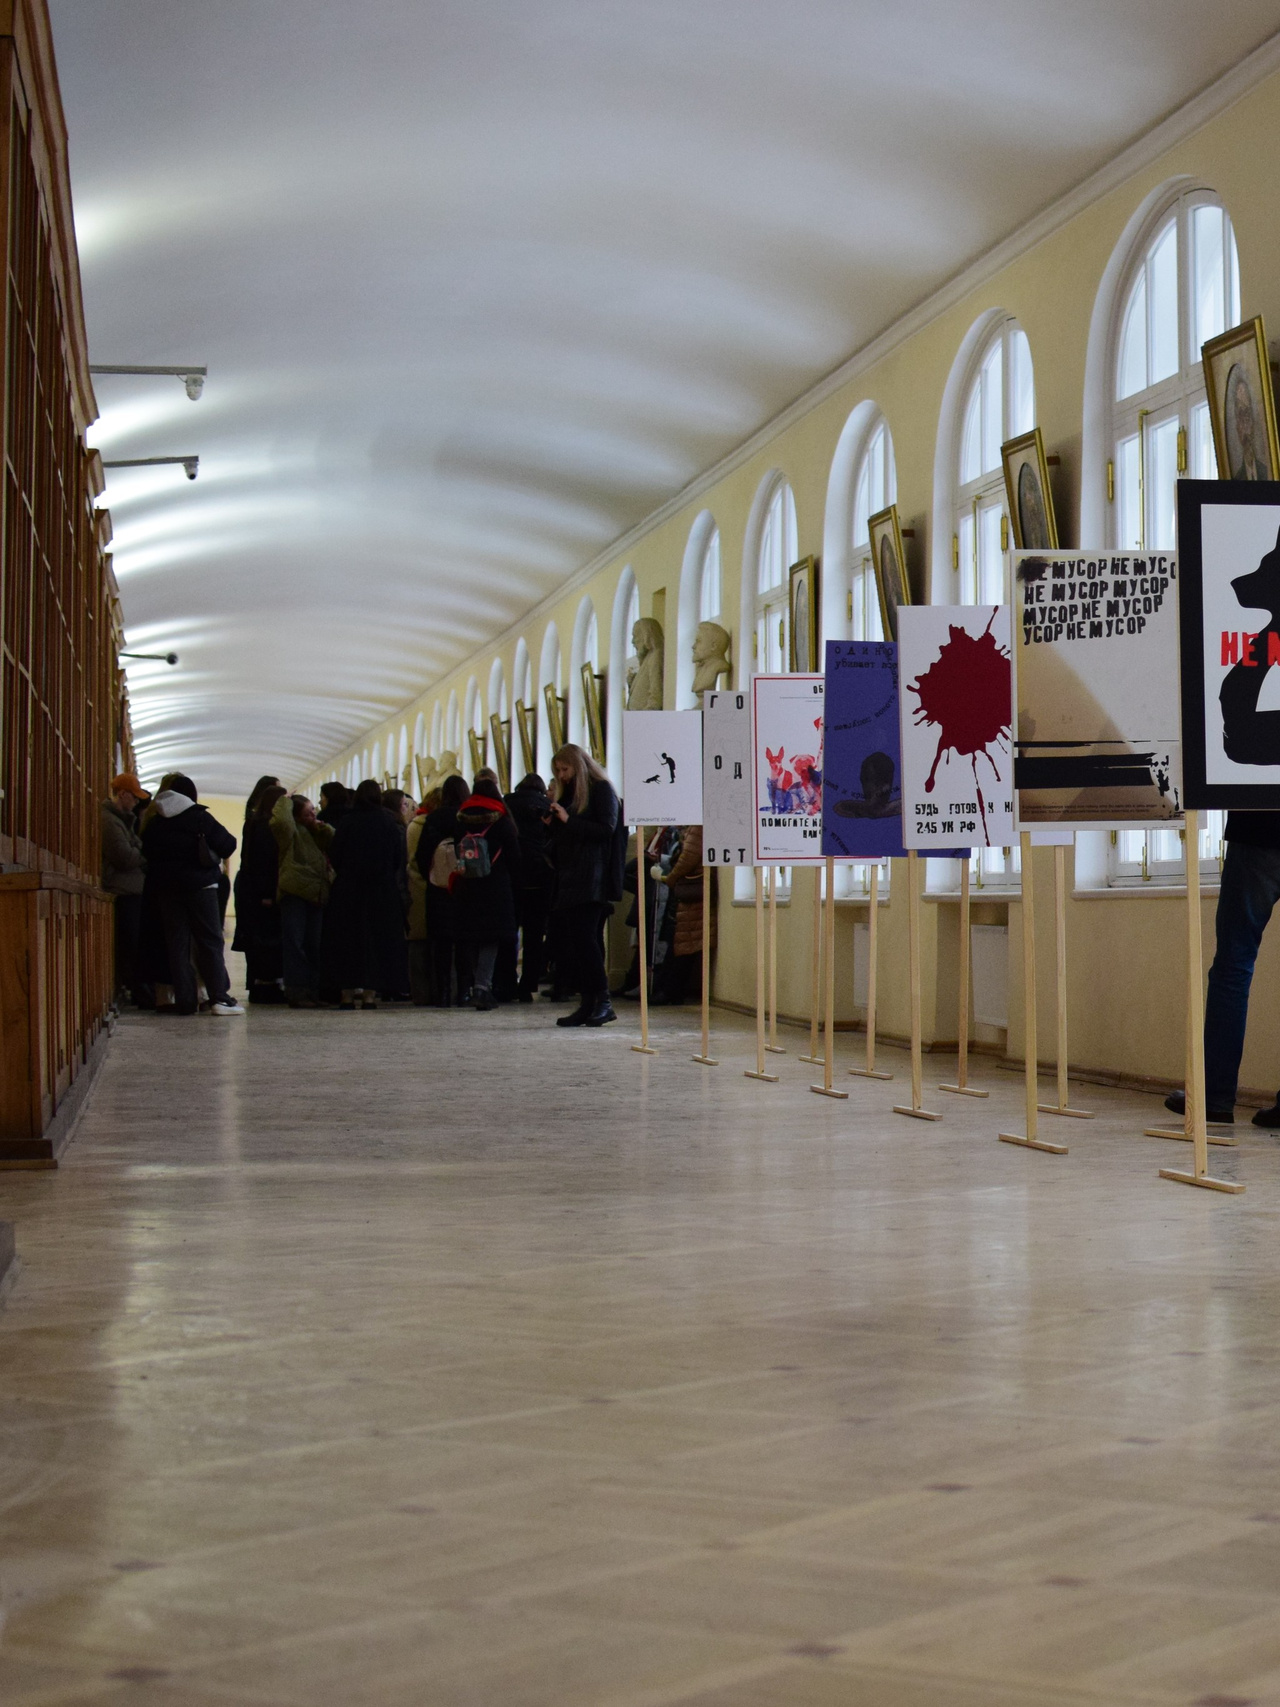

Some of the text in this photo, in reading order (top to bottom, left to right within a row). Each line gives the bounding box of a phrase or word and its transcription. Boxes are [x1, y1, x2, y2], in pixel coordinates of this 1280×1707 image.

[1052, 558, 1107, 580] МУСОР
[1110, 557, 1130, 576] НЕ
[1024, 577, 1169, 604] НЕ МУСОР МУСОР
[1023, 594, 1163, 626] МУСОР НЕ МУСОР
[1023, 616, 1146, 645] УСОР НЕ МУСОР
[1221, 631, 1259, 667] НЕ
[915, 804, 939, 816] БУДЬ
[949, 803, 977, 815] ГОТОВ
[761, 818, 809, 827] ПОМОГИТЕ
[916, 821, 976, 833] 245 УК РФ
